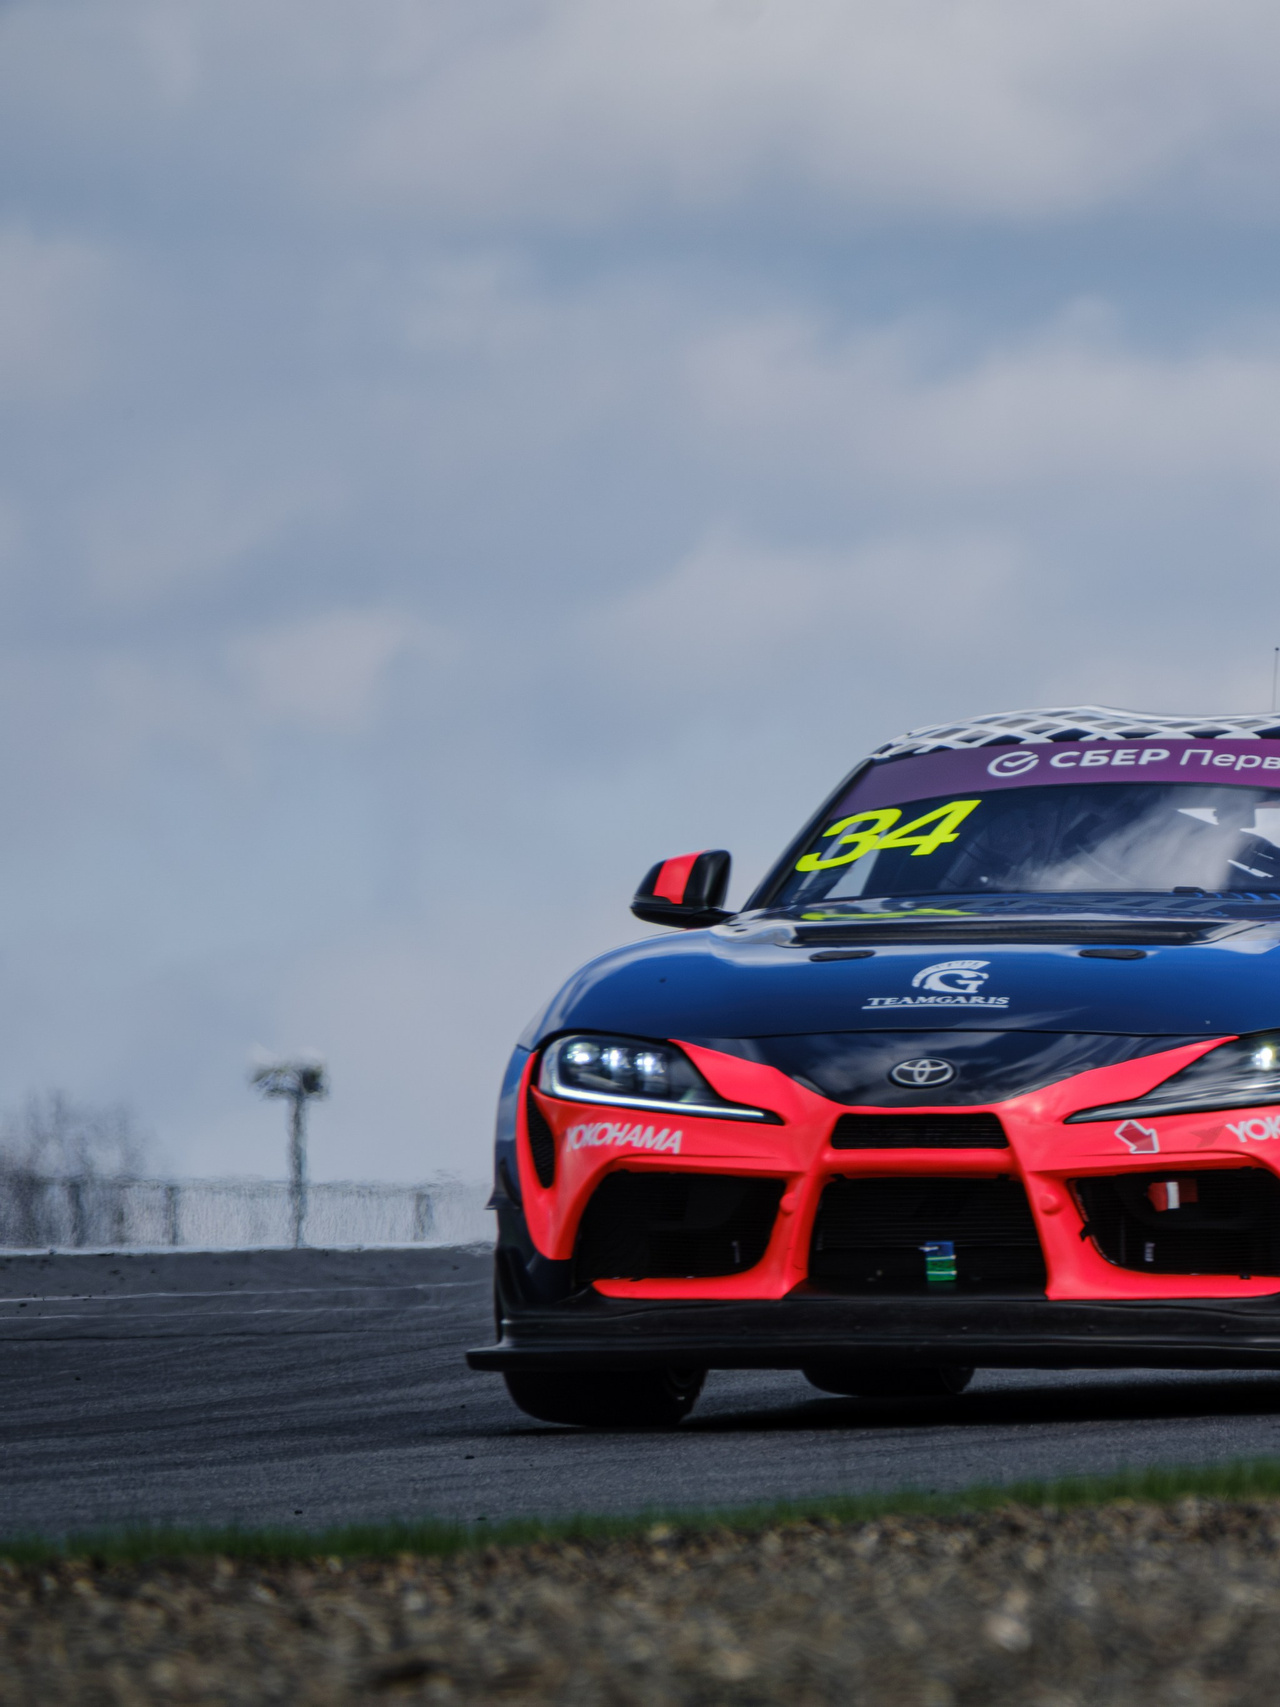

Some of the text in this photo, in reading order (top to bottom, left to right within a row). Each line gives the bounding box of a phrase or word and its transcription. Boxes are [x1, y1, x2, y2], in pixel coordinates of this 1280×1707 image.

[1050, 748, 1170, 768] СБЕР
[795, 800, 982, 872] 34
[866, 996, 1010, 1006] TEAMGARIS
[566, 1122, 683, 1154] YOKOHAMA
